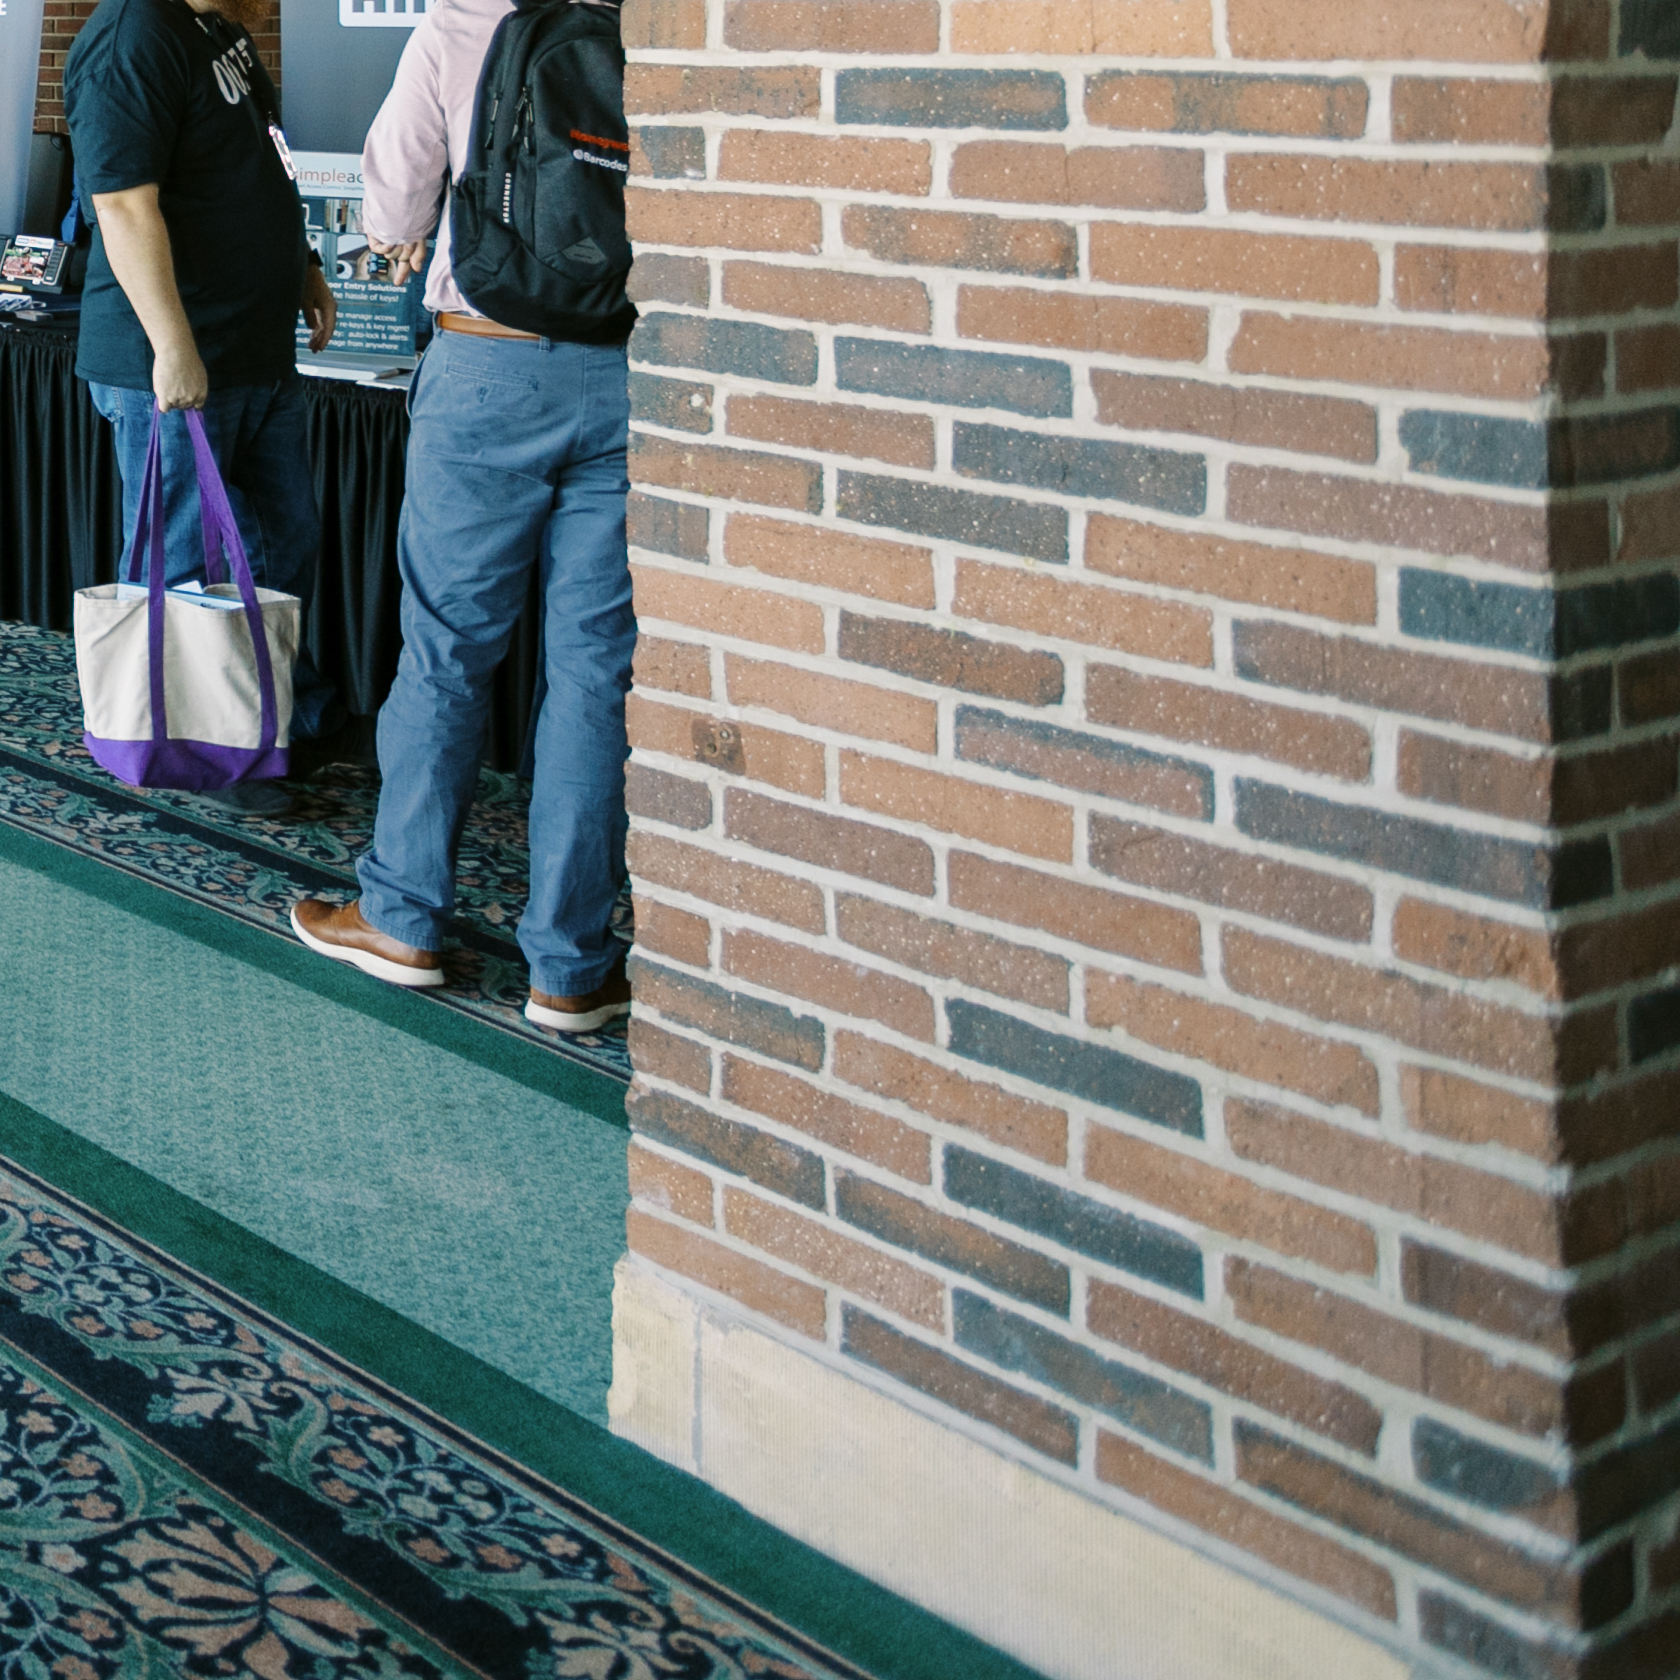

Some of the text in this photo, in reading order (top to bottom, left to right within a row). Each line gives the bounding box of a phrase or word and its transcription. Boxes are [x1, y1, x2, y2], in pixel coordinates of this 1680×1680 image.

[583, 151, 629, 172] Barcodes
[296, 167, 364, 186] impleac
[344, 282, 366, 291] Entry
[367, 283, 407, 293] Solutions
[345, 292, 368, 300] hassle
[369, 293, 378, 301] of
[379, 293, 399, 303] keys!
[345, 313, 373, 321] manage
[373, 323, 385, 331] key
[348, 331, 380, 339] auto-lock
[364, 342, 398, 351] anywhere
